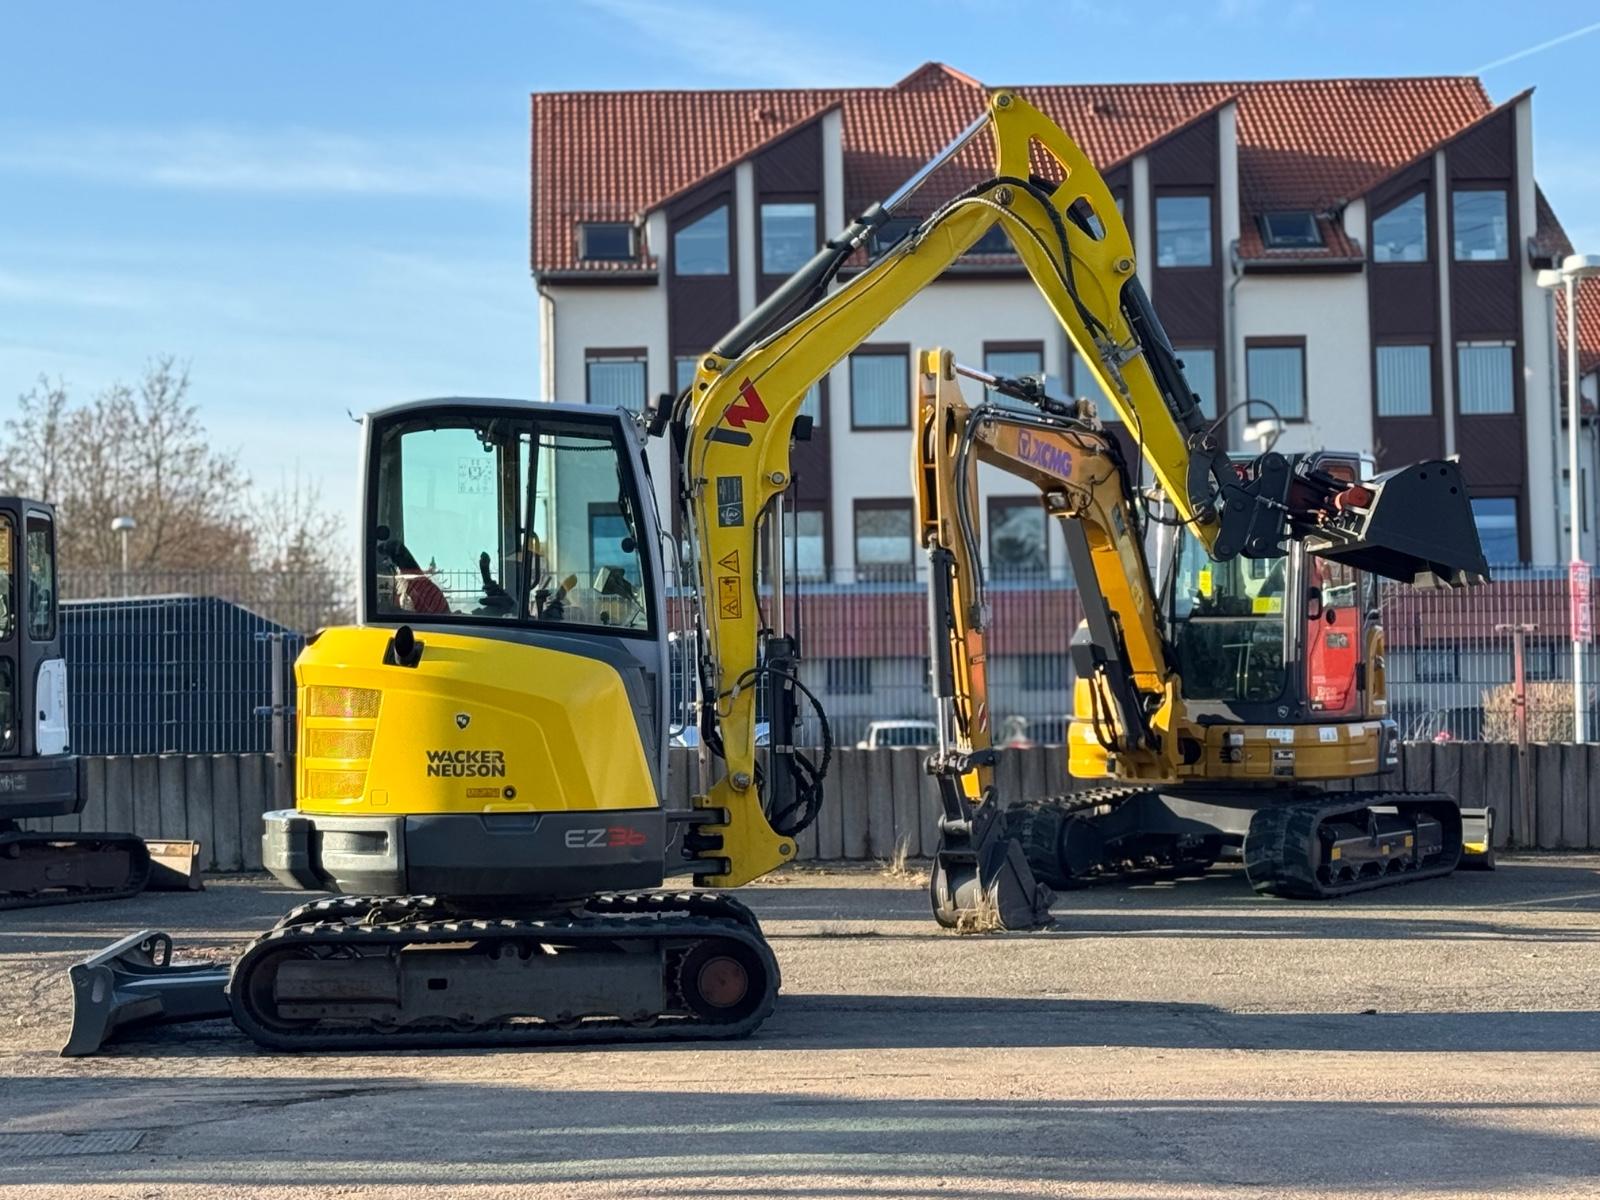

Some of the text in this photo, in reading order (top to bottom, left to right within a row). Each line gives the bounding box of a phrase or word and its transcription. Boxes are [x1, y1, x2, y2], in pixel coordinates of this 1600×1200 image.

[1028, 438, 1073, 478] XCMG
[426, 750, 505, 764] WACKER
[427, 764, 506, 777] NEUSON
[565, 826, 646, 848] EZ36
